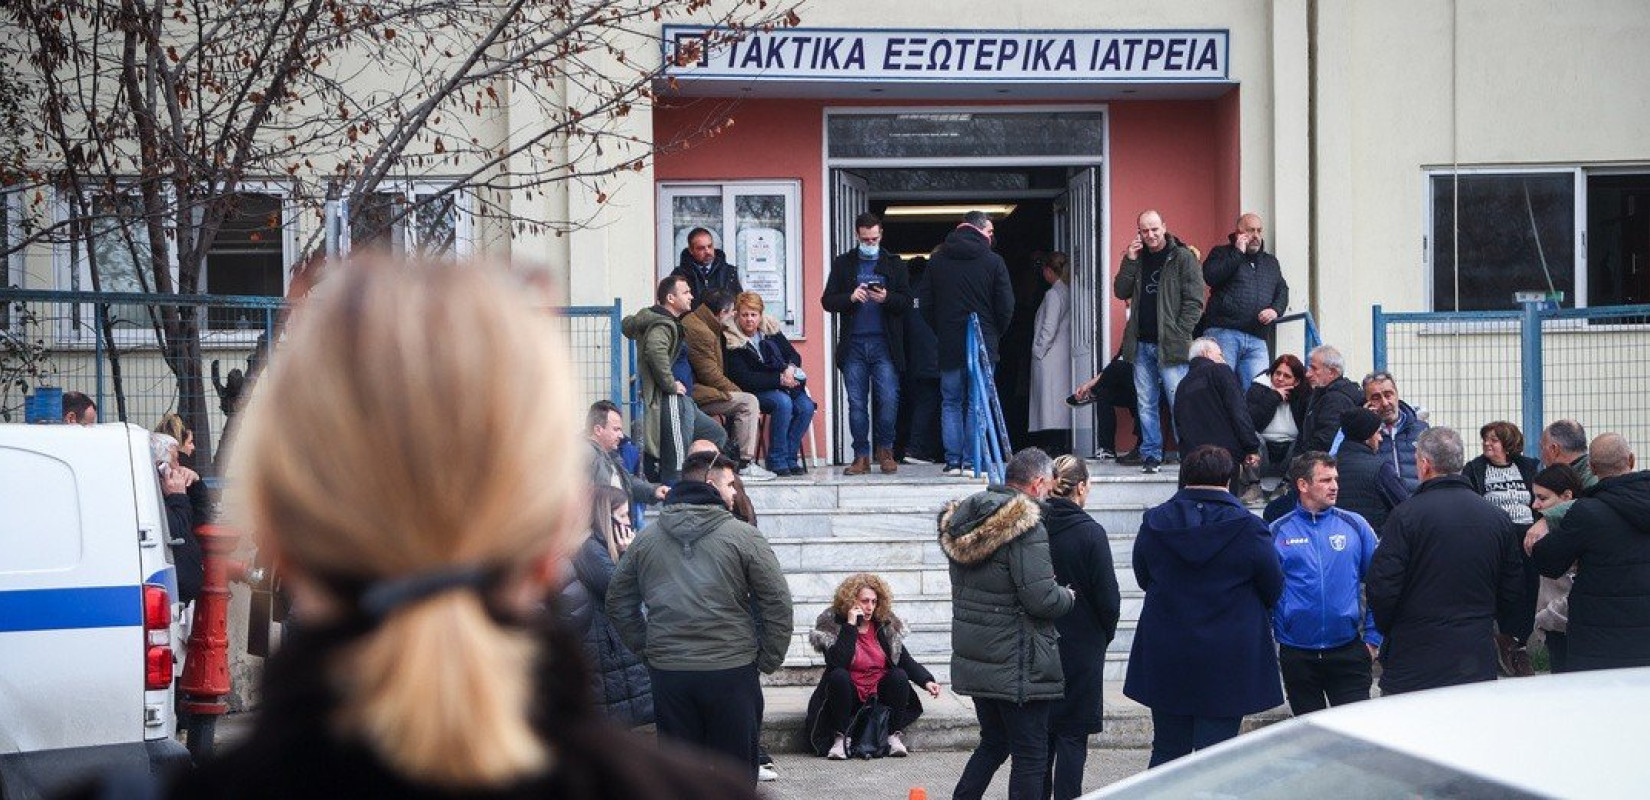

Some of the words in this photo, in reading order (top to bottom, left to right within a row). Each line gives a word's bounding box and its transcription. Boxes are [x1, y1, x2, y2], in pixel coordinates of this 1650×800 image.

[727, 36, 866, 69] ΤΑΚΤΙΚΑ
[882, 38, 1077, 71] ΕΞΩΤΕΡΙΚΑ
[1089, 38, 1218, 71] ΙΑΤΡΕΙΑ
